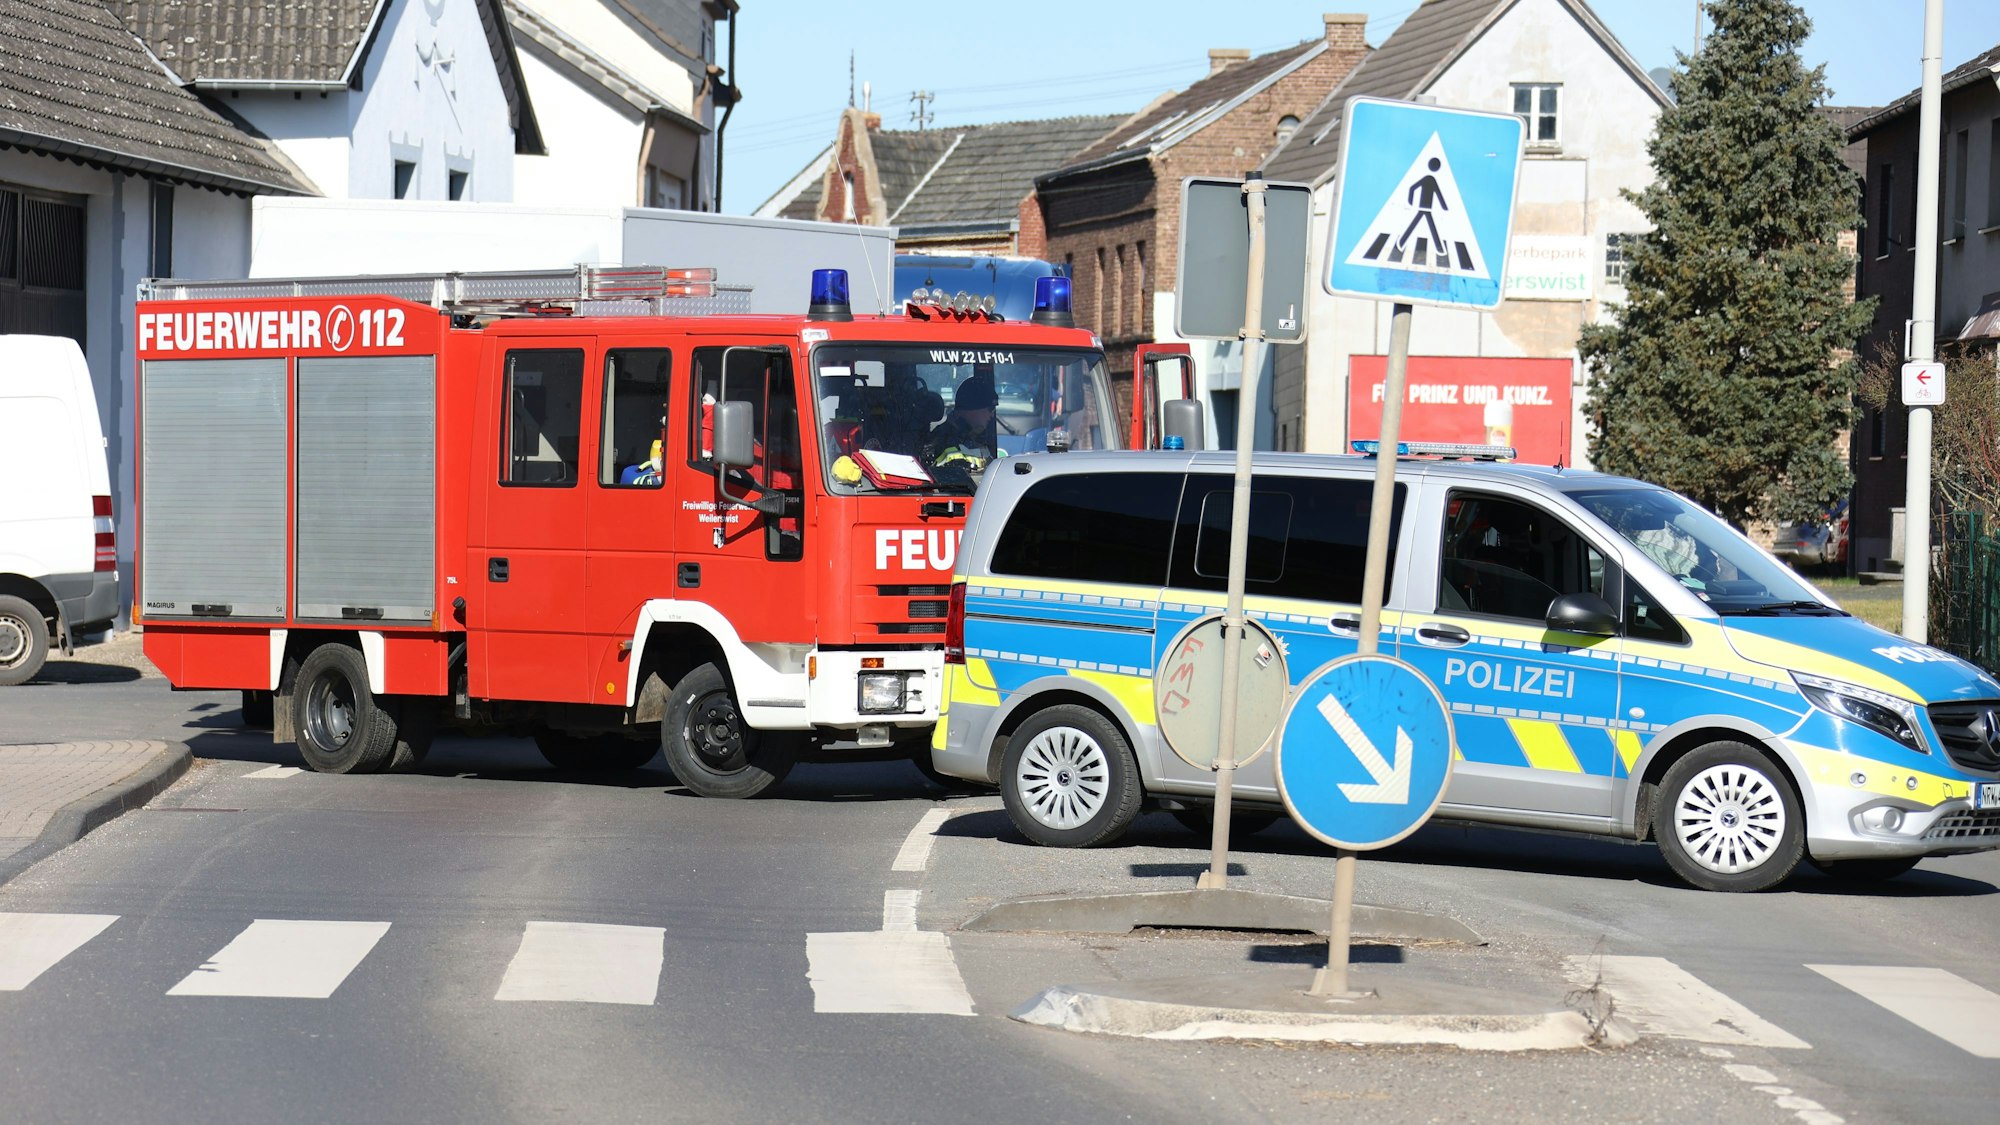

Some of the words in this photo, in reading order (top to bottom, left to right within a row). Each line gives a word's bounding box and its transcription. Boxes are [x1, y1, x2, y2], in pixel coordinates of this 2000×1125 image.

[1509, 245, 1586, 261] erbepark
[1505, 271, 1586, 290] erswist
[139, 310, 321, 351] FEUERWEHR
[359, 308, 405, 347] 112
[930, 350, 959, 363] WLW
[961, 351, 976, 363] 22
[977, 352, 1014, 364] LF10-1
[1409, 384, 1459, 404] PRINZ
[1463, 385, 1498, 405] UND
[1503, 386, 1552, 405] KUNZ.
[682, 501, 718, 511] Freiwillige
[719, 501, 756, 511] Feuerw
[699, 514, 739, 523] Weilerswist
[875, 529, 963, 571] FEU
[1444, 657, 1575, 698] POLIZEI
